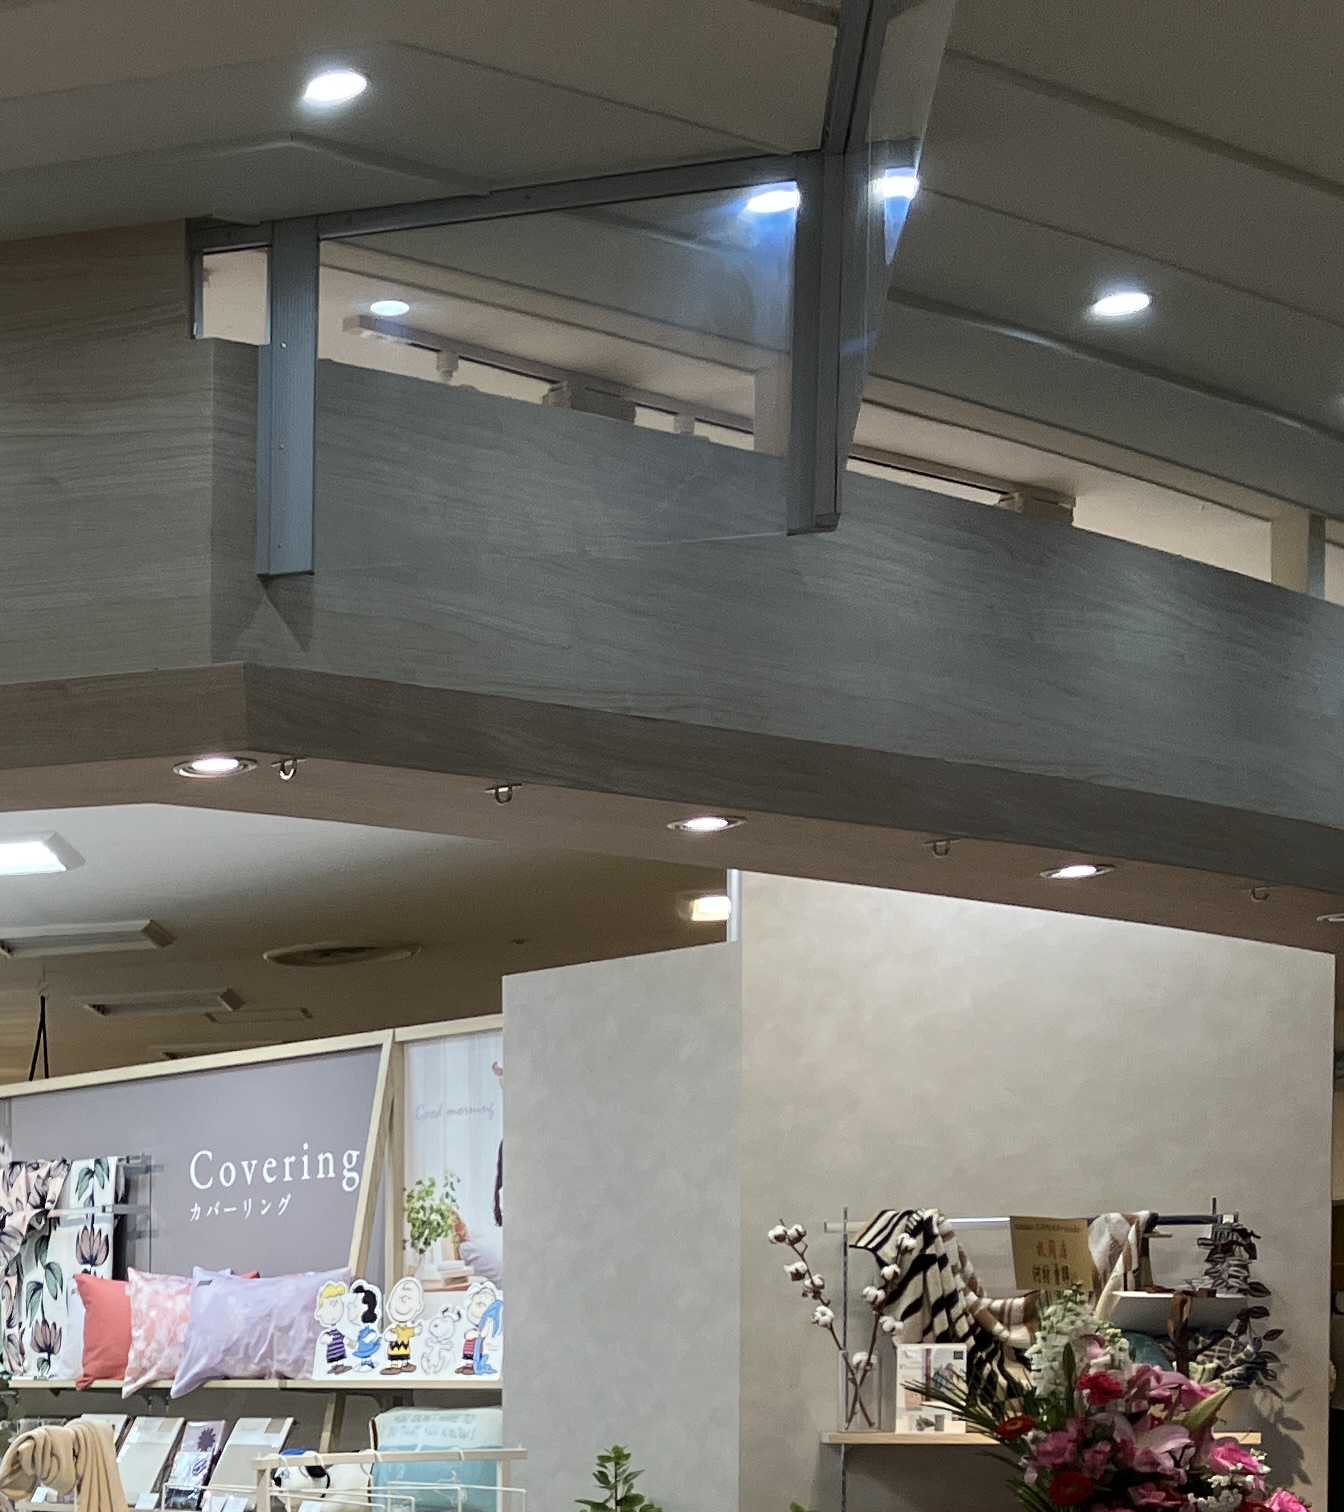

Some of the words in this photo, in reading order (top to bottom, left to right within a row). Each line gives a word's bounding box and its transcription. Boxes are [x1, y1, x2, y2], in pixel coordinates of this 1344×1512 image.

[189, 1142, 360, 1192] Covering
[189, 1192, 292, 1222] カバーリング
